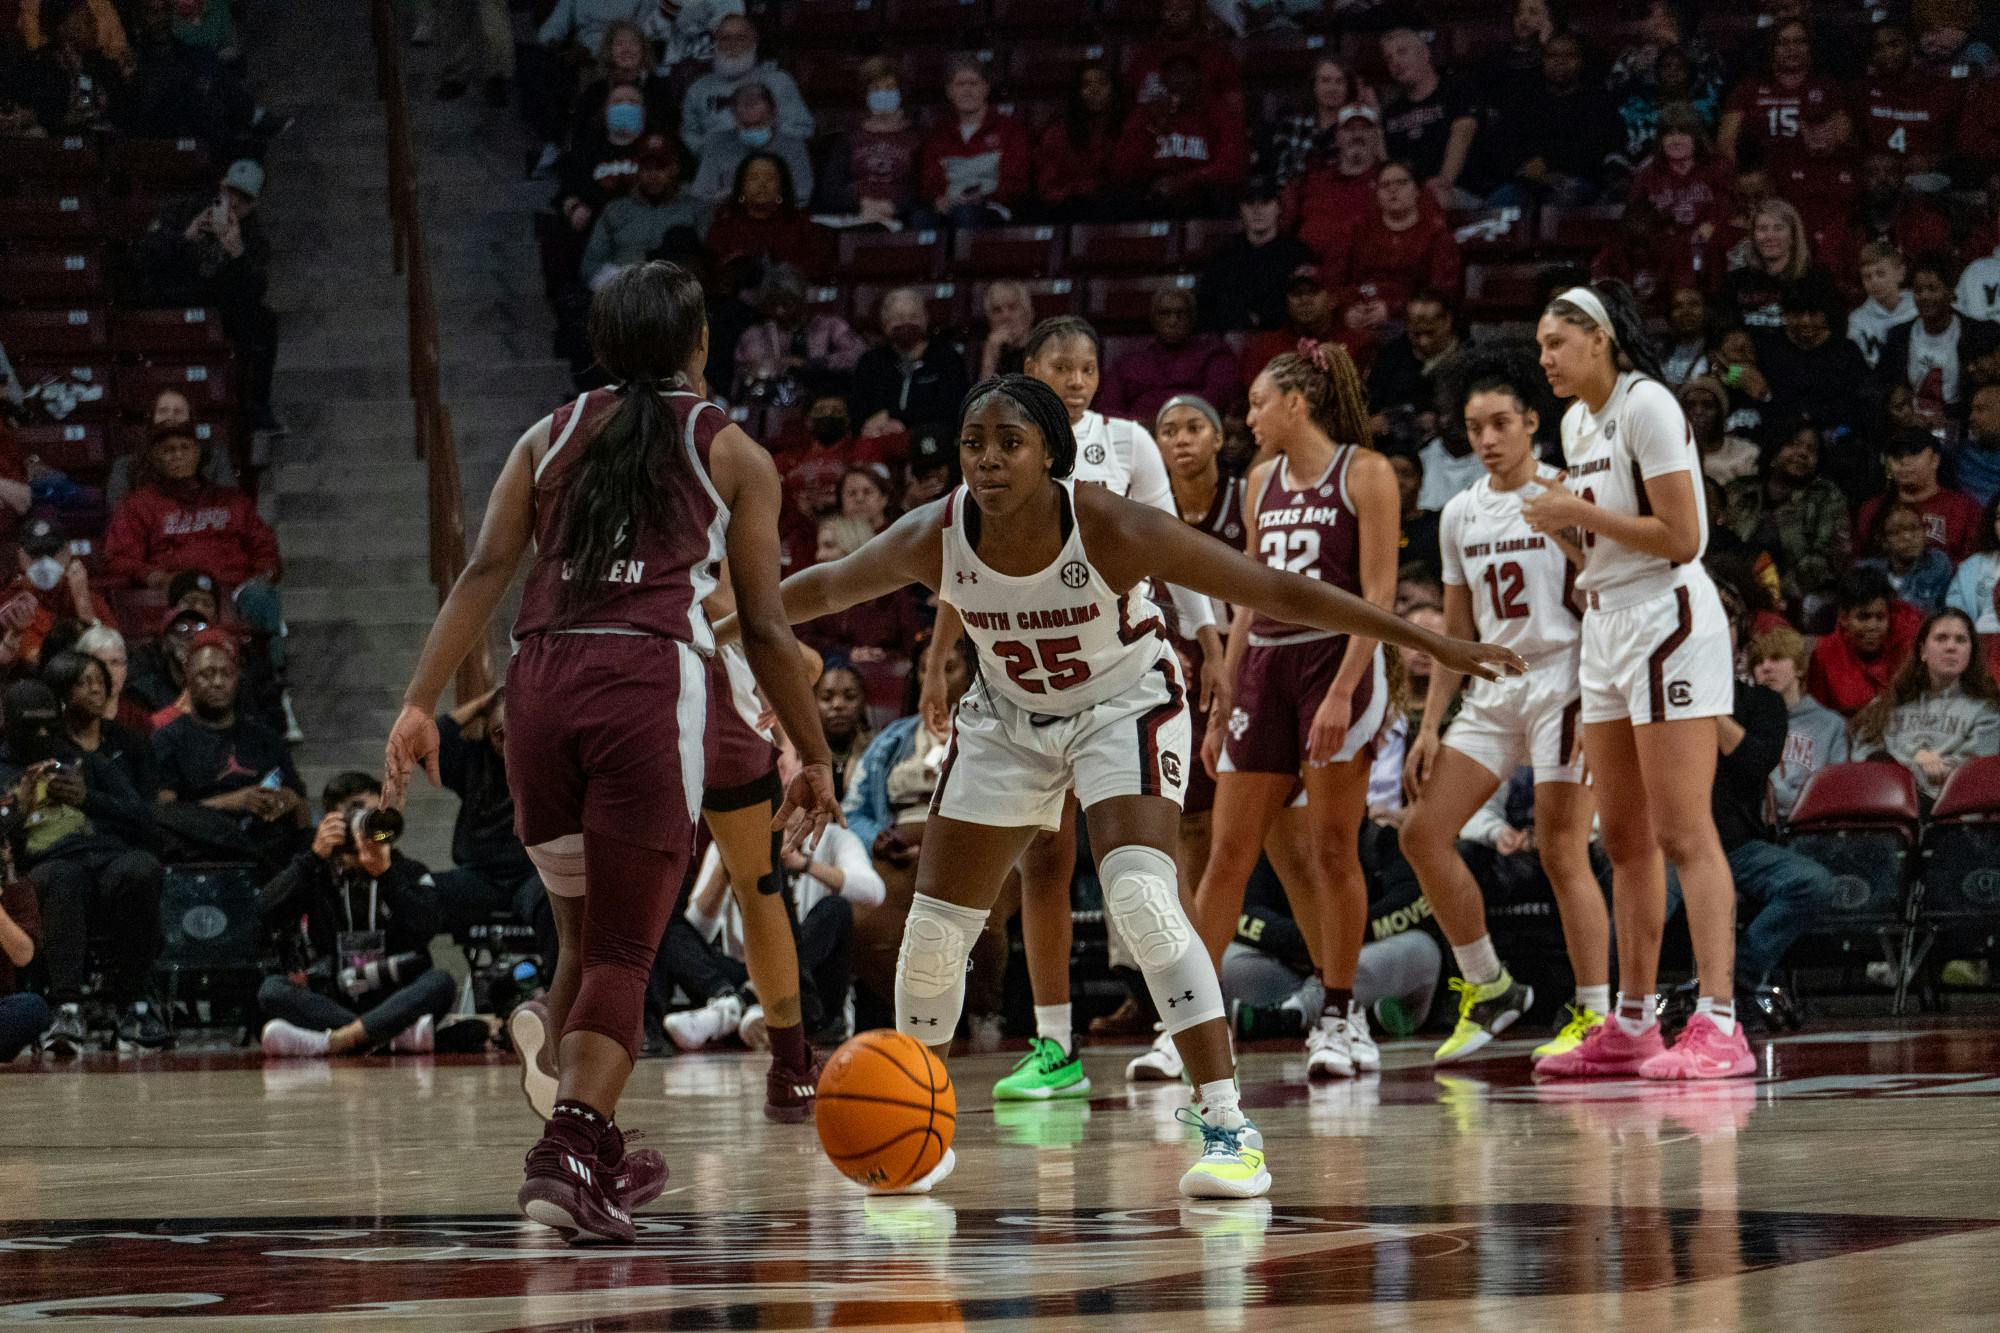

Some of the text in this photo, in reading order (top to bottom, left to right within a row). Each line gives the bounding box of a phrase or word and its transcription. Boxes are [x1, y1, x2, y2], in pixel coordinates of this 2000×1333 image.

[1767, 107, 1799, 137] 15
[1888, 127, 1904, 153] 4
[1258, 506, 1338, 530] TEXAS A&M
[1260, 528, 1321, 580] 32
[1465, 536, 1546, 558] SOUTH CAROLINA
[1061, 561, 1088, 588] SEC
[1484, 562, 1530, 619] 12
[1016, 602, 1101, 630] CAROLINA
[992, 635, 1092, 695] 25
[1371, 895, 1433, 941] MOVE
